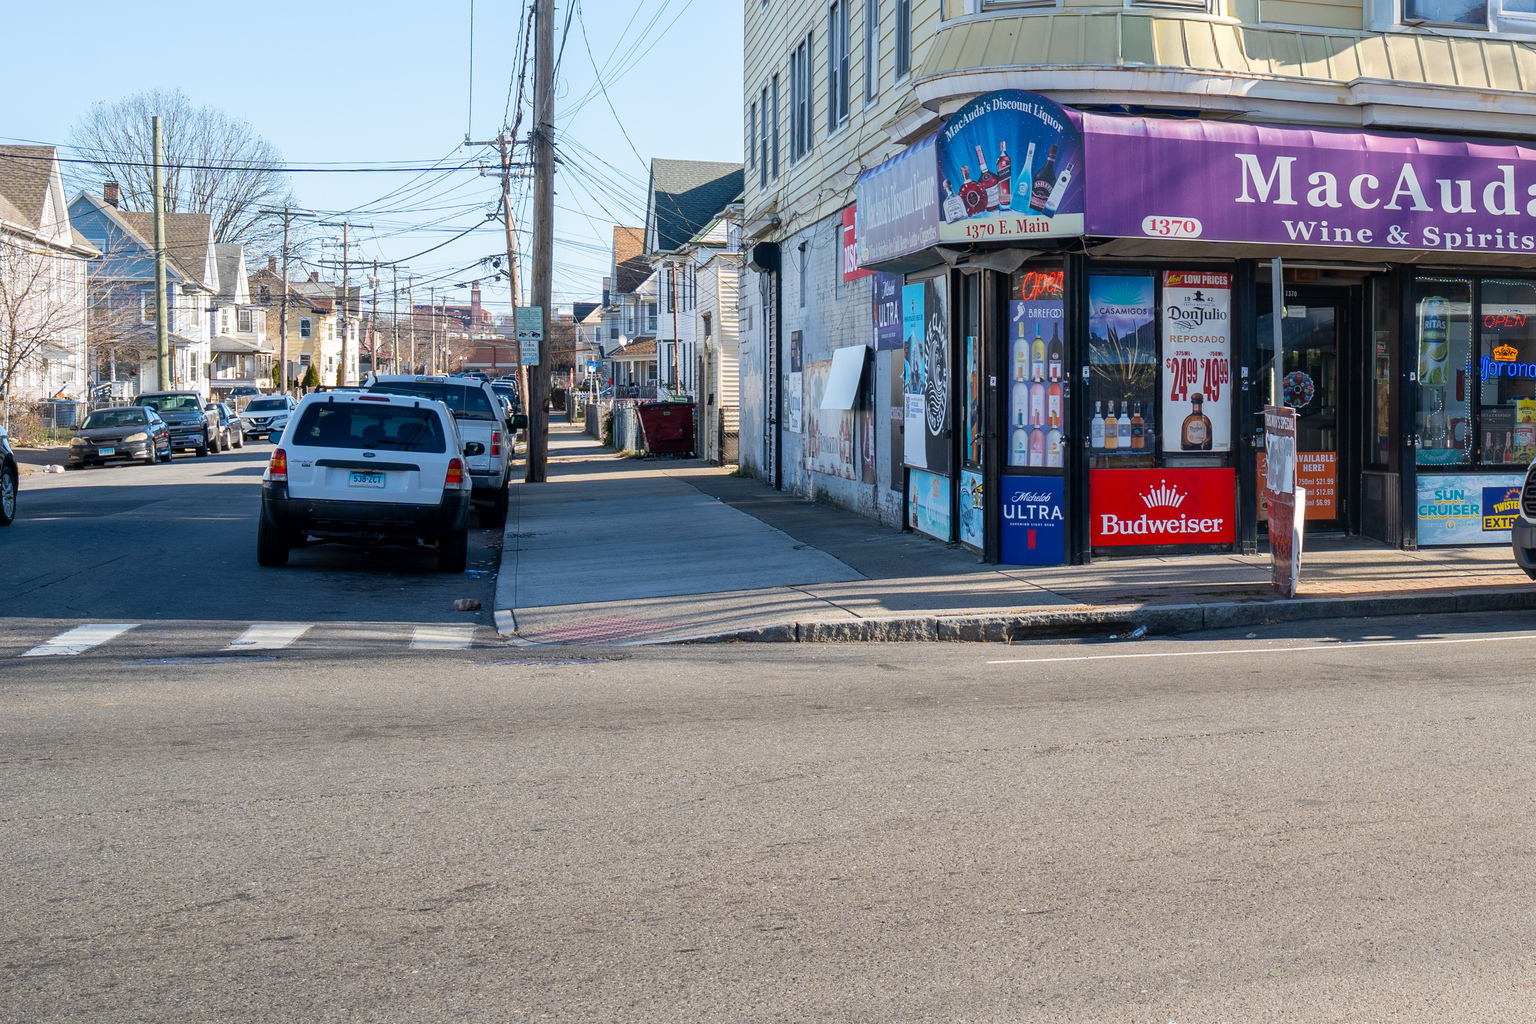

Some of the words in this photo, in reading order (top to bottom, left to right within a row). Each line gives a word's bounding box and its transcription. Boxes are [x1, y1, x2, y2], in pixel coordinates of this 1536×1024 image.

[945, 102, 991, 142] MacAuda's
[993, 97, 1033, 113] Discount
[1034, 104, 1064, 133] Liquor
[966, 223, 995, 239] 1370
[999, 220, 1012, 234] E.
[1016, 218, 1050, 233] Main
[1149, 218, 1196, 236] 1370
[1282, 220, 1373, 243] Wine
[1387, 225, 1411, 244] &
[1422, 227, 1534, 251] Spirits
[1022, 271, 1064, 301] Open
[1184, 275, 1201, 284] LOW
[1202, 275, 1228, 285] PRICES
[878, 301, 899, 327] ULTRA
[1100, 307, 1148, 315] CASAMIGOS
[1424, 319, 1446, 330] RITAS
[1484, 314, 1528, 328] OPEN
[1169, 335, 1226, 343] REPOSADO
[1296, 454, 1334, 462] AVAILABLE
[1303, 464, 1325, 472] HERE!
[1011, 491, 1052, 502] Michelob
[1434, 489, 1465, 503] SUN
[1003, 504, 1063, 520] ULTRA
[1418, 504, 1480, 519] CRUISER
[1493, 500, 1520, 513] TWISTE
[1100, 513, 1223, 535] Budweiser
[1485, 517, 1515, 528] EXTR
